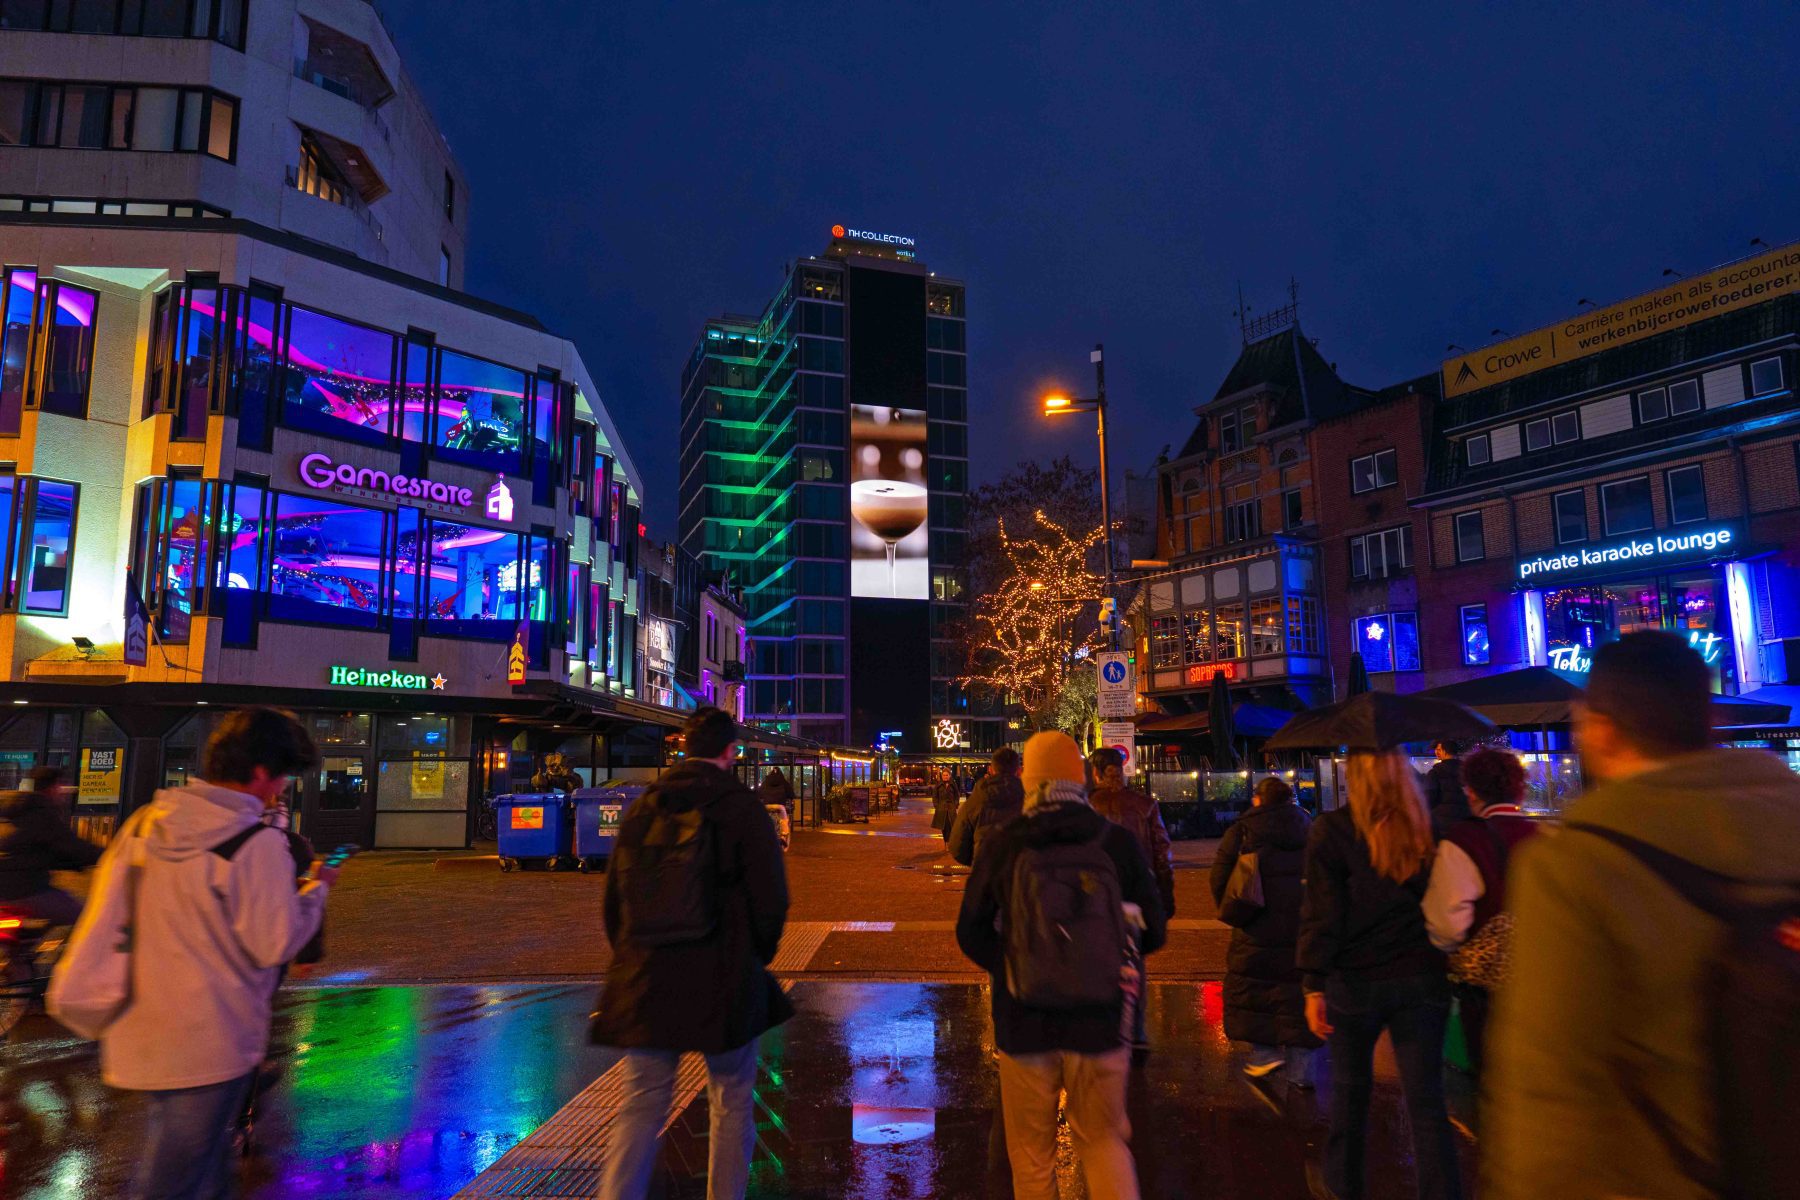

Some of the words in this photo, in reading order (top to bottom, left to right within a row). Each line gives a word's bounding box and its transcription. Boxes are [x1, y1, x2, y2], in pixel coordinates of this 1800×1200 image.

[861, 231, 915, 246] COLLECTION
[1564, 309, 1625, 338] Carrière
[1629, 291, 1683, 319] maken
[1688, 280, 1713, 298] als
[1578, 272, 1800, 350] werkenbijcrowefoederer.
[1485, 345, 1542, 374] Crowe
[480, 421, 509, 433] HALO
[335, 486, 412, 507] WINNERS
[426, 503, 466, 515] ONLY
[1520, 555, 1579, 578] private
[1581, 541, 1654, 566] karaoke
[1657, 530, 1731, 554] lounge
[1548, 644, 1593, 673] Toky
[330, 666, 427, 689] Heineken
[933, 723, 960, 738] LOU
[91, 758, 114, 766] GOED
[92, 751, 115, 759] VAST
